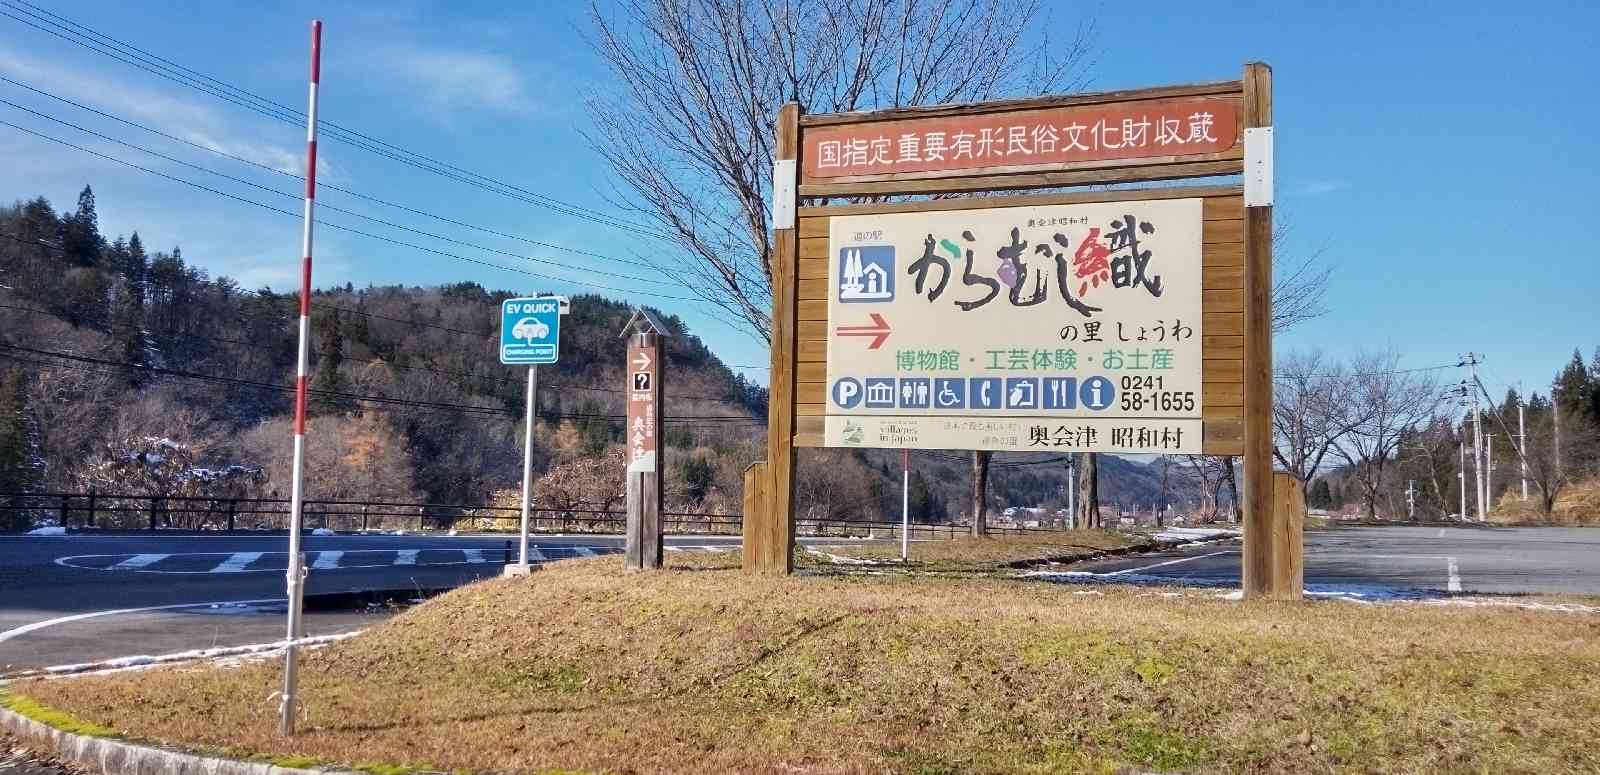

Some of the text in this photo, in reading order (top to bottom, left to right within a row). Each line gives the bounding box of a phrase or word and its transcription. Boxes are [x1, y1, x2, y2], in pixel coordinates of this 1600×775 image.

[817, 111, 1218, 169] 国指定重要有形民俗文化財収蔵
[907, 213, 1165, 317] からむし織
[507, 303, 556, 314] EV QUICK
[1060, 319, 1193, 342] の里 しょうわ
[1121, 375, 1163, 390] 0241
[1120, 391, 1195, 411] 58-1655
[1029, 425, 1098, 448] 奥会津
[1111, 426, 1184, 449] 昭和村
